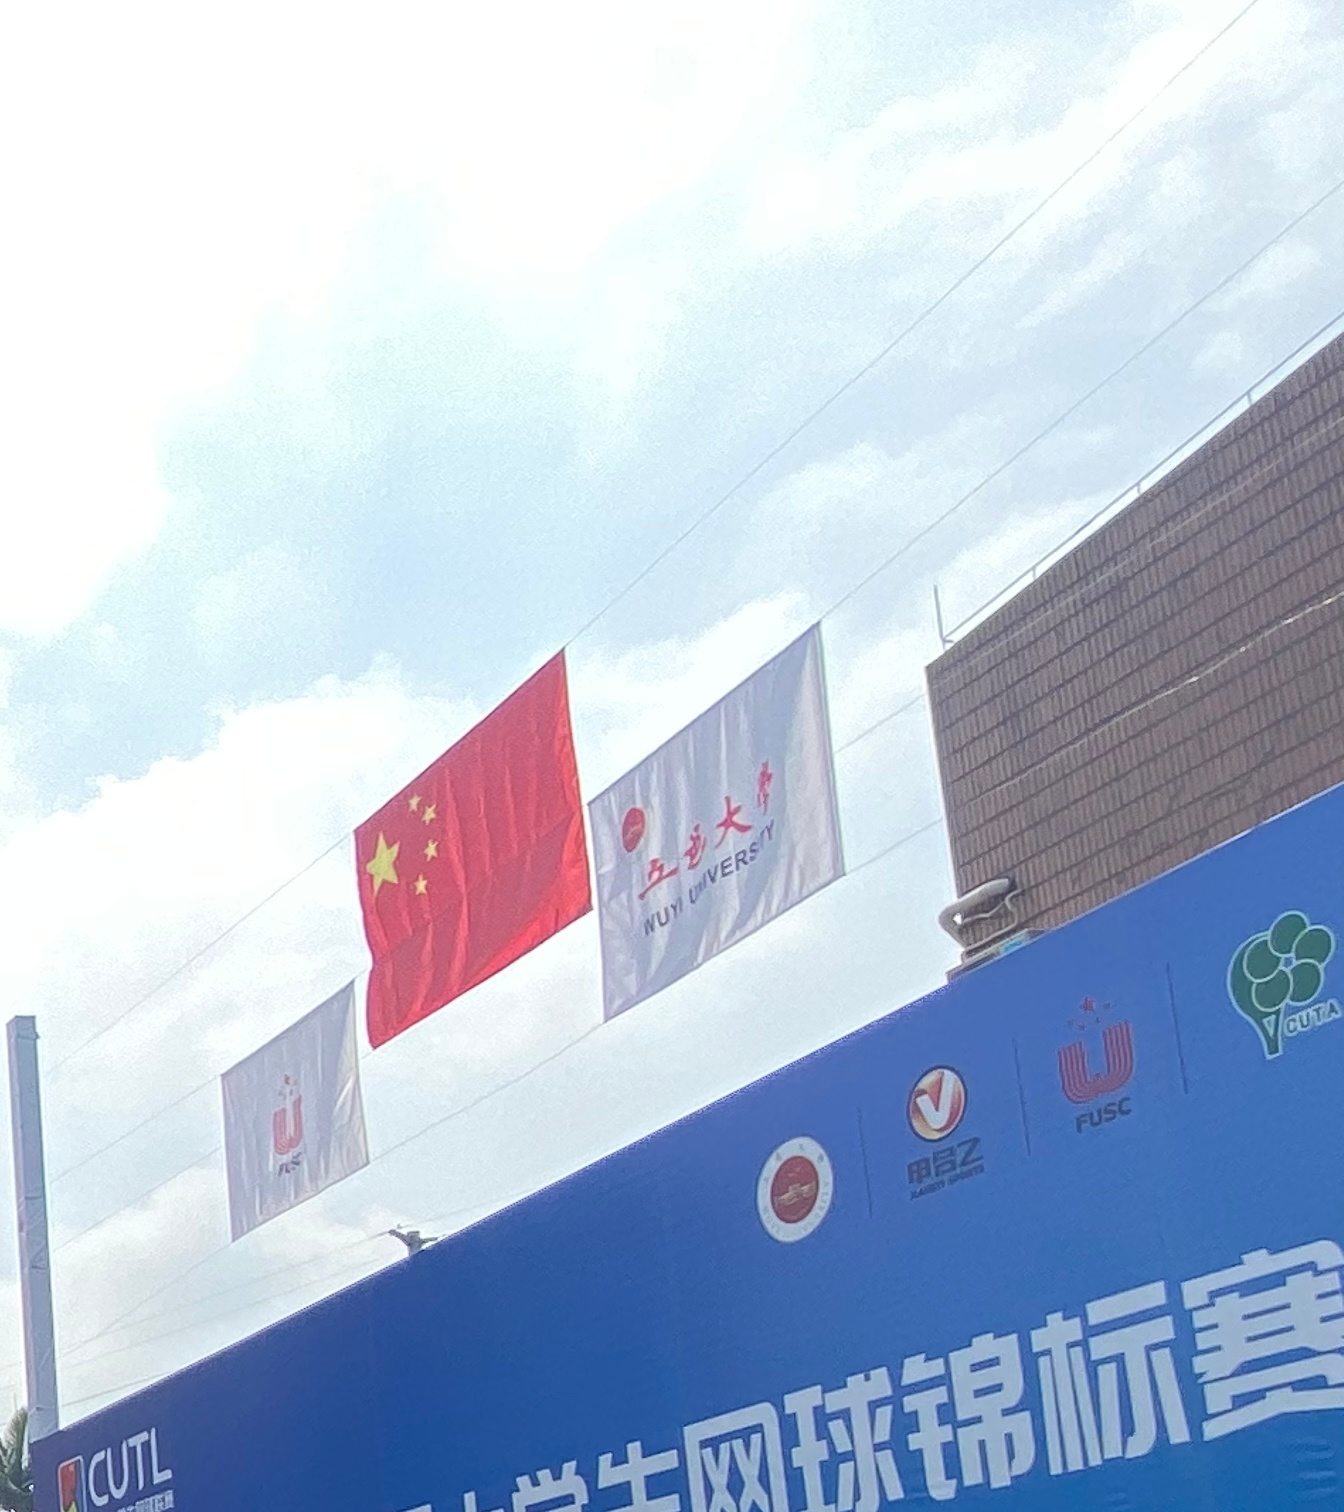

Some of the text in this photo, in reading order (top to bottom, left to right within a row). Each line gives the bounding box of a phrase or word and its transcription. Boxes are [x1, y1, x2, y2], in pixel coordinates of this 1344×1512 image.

[643, 897, 683, 937] WUYI
[1285, 999, 1342, 1036] CUTA
[1076, 1097, 1132, 1134] FUSC
[88, 1427, 173, 1506] CUTL
